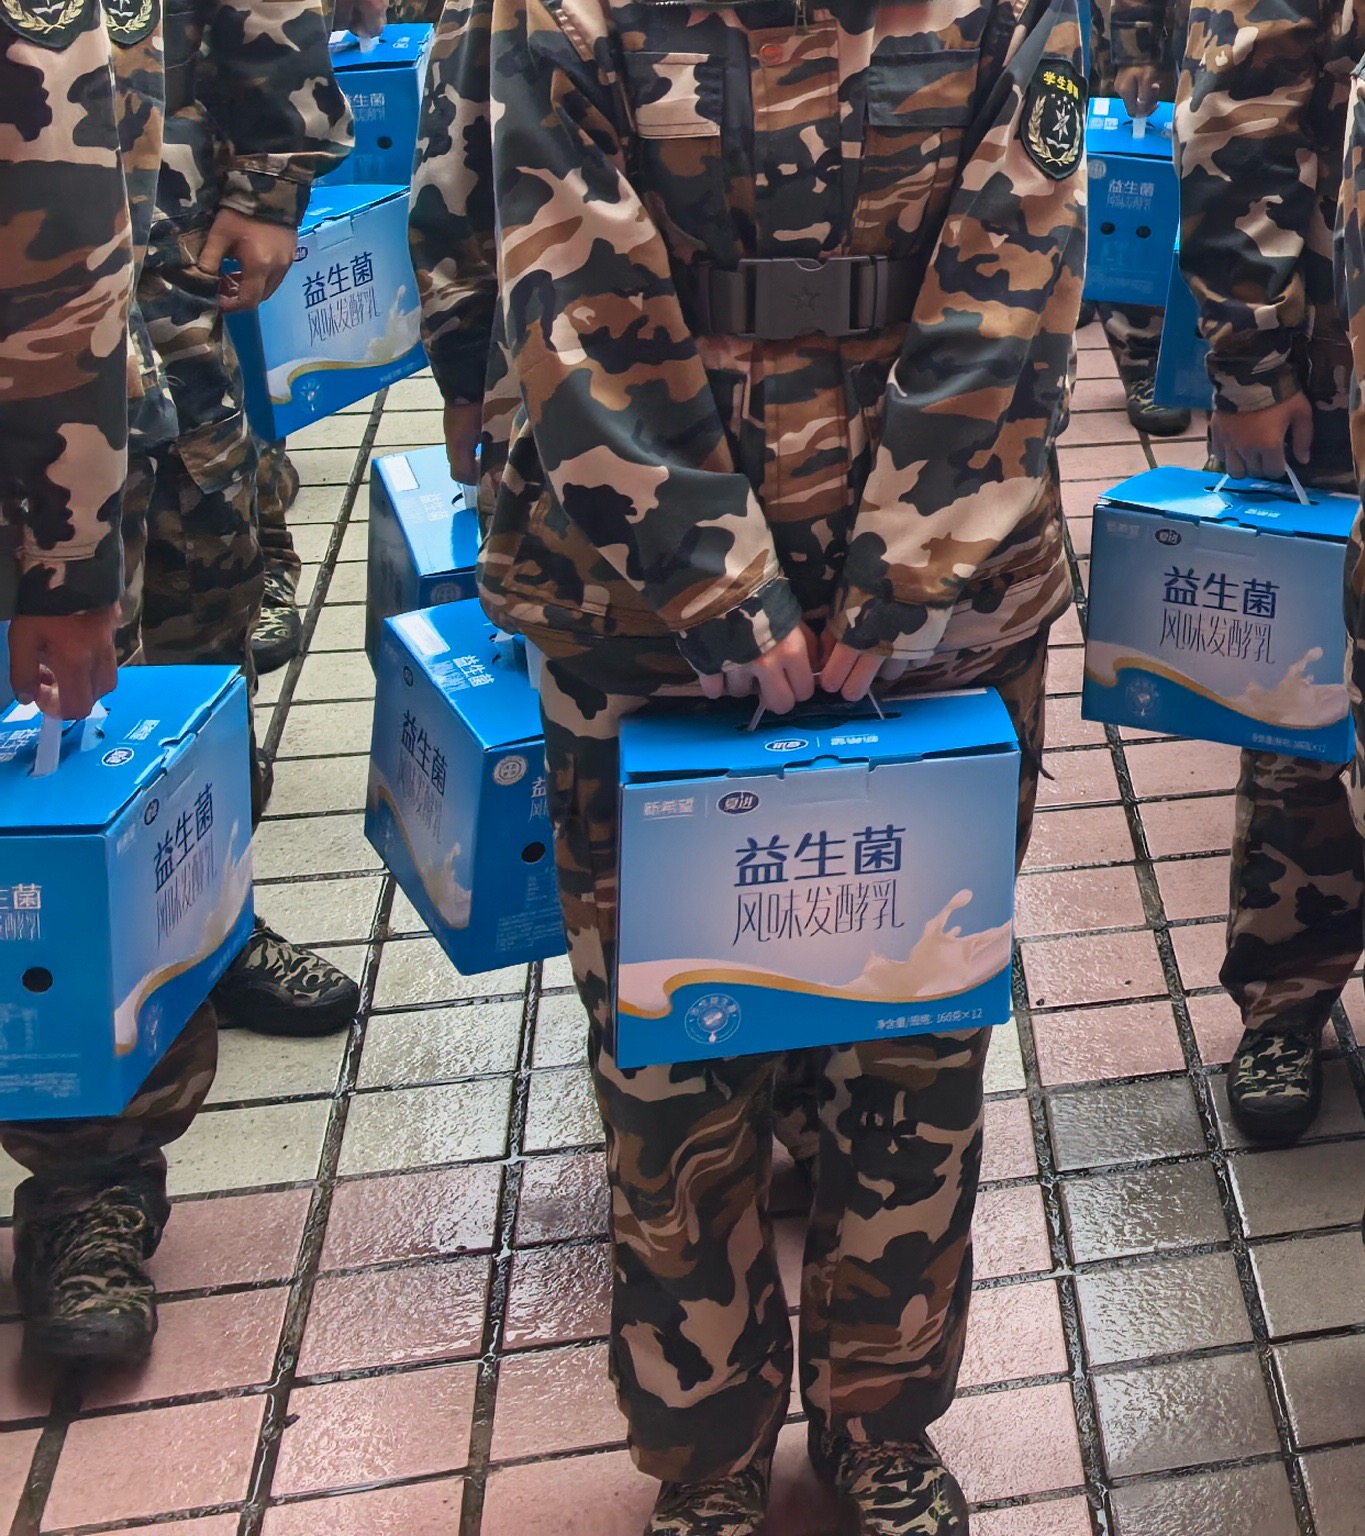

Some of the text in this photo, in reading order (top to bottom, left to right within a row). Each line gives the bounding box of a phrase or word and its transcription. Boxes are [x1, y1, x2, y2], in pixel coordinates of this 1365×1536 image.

[302, 252, 375, 310] 益生菌
[1162, 566, 1281, 619] 益生菌
[1159, 608, 1275, 664] 风味发酵乳
[400, 709, 447, 797] 益生菌
[153, 781, 214, 894] 益生菌
[734, 824, 907, 887] 益生菌
[731, 878, 906, 947] 风味发酵乳
